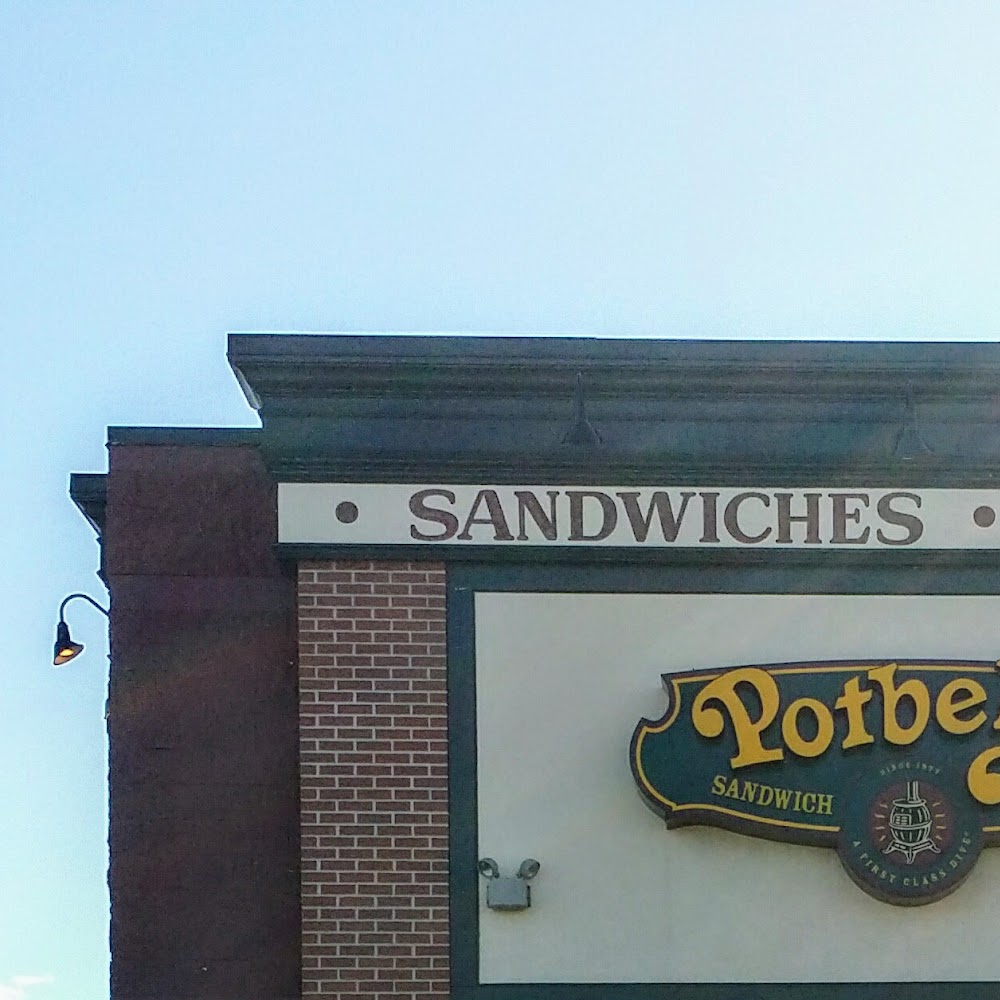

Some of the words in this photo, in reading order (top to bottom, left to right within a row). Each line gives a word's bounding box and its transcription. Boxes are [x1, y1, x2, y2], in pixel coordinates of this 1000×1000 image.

[408, 489, 924, 545] SANDWICHES
[711, 774, 834, 815] SANDWICH
[860, 852, 897, 884] FIRST
[903, 868, 947, 887] CLASS
